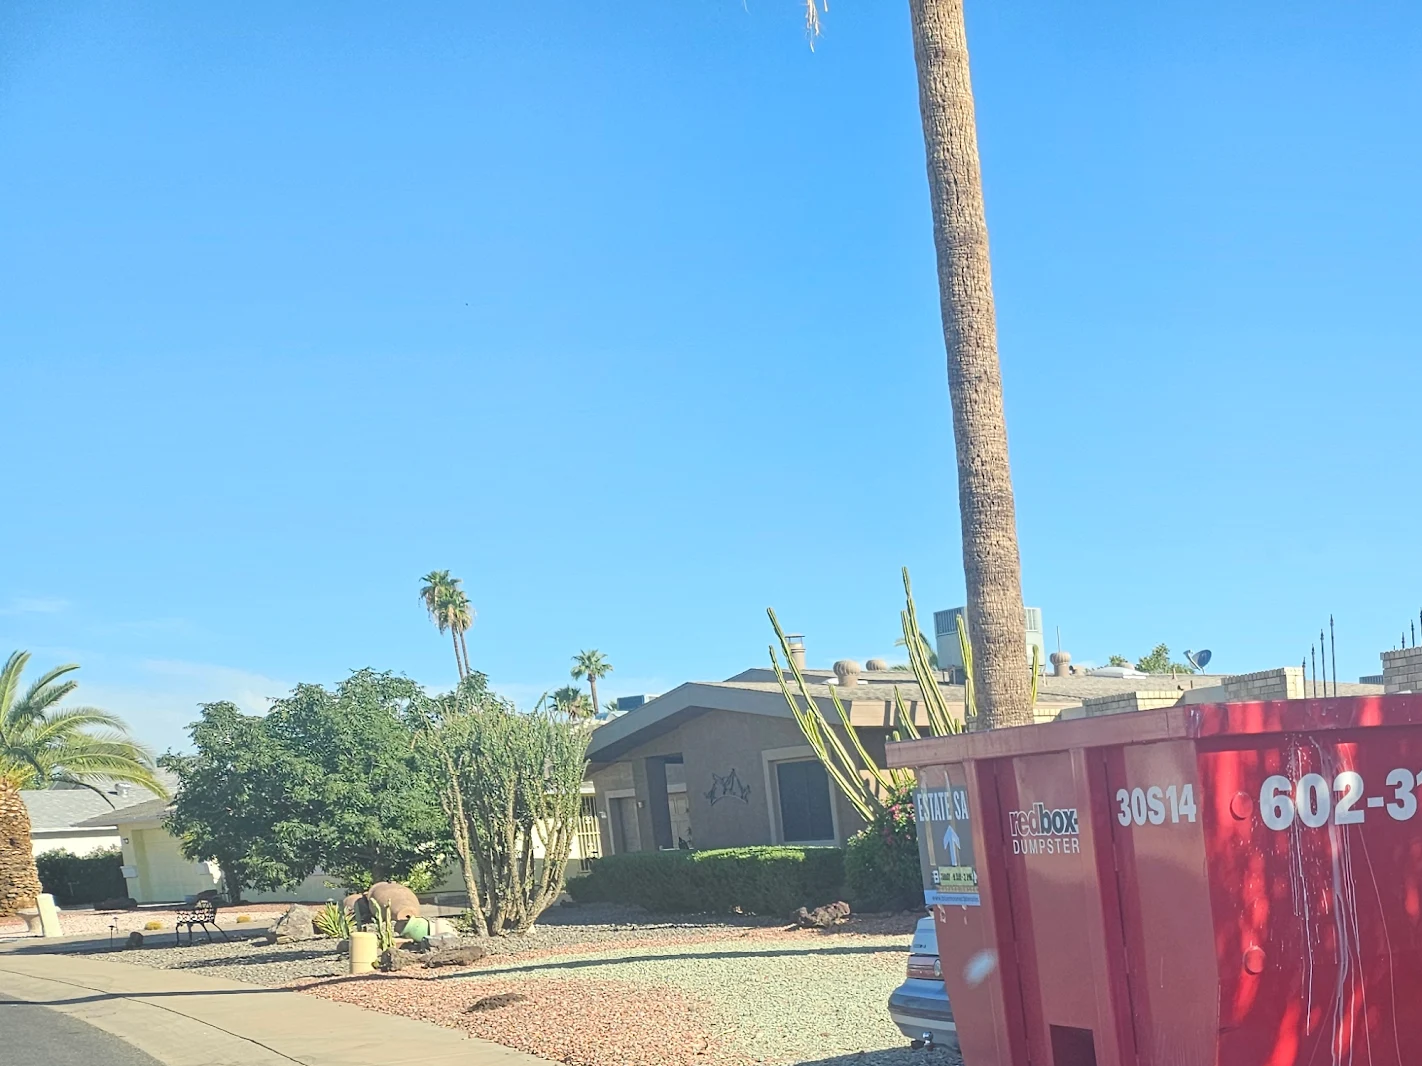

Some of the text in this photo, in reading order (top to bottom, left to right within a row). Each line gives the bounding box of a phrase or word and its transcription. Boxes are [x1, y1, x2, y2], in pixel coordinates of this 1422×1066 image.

[916, 790, 969, 822] ESTATE SA
[1116, 784, 1197, 827] 30S14
[1013, 838, 1080, 855] DUMPSTER
